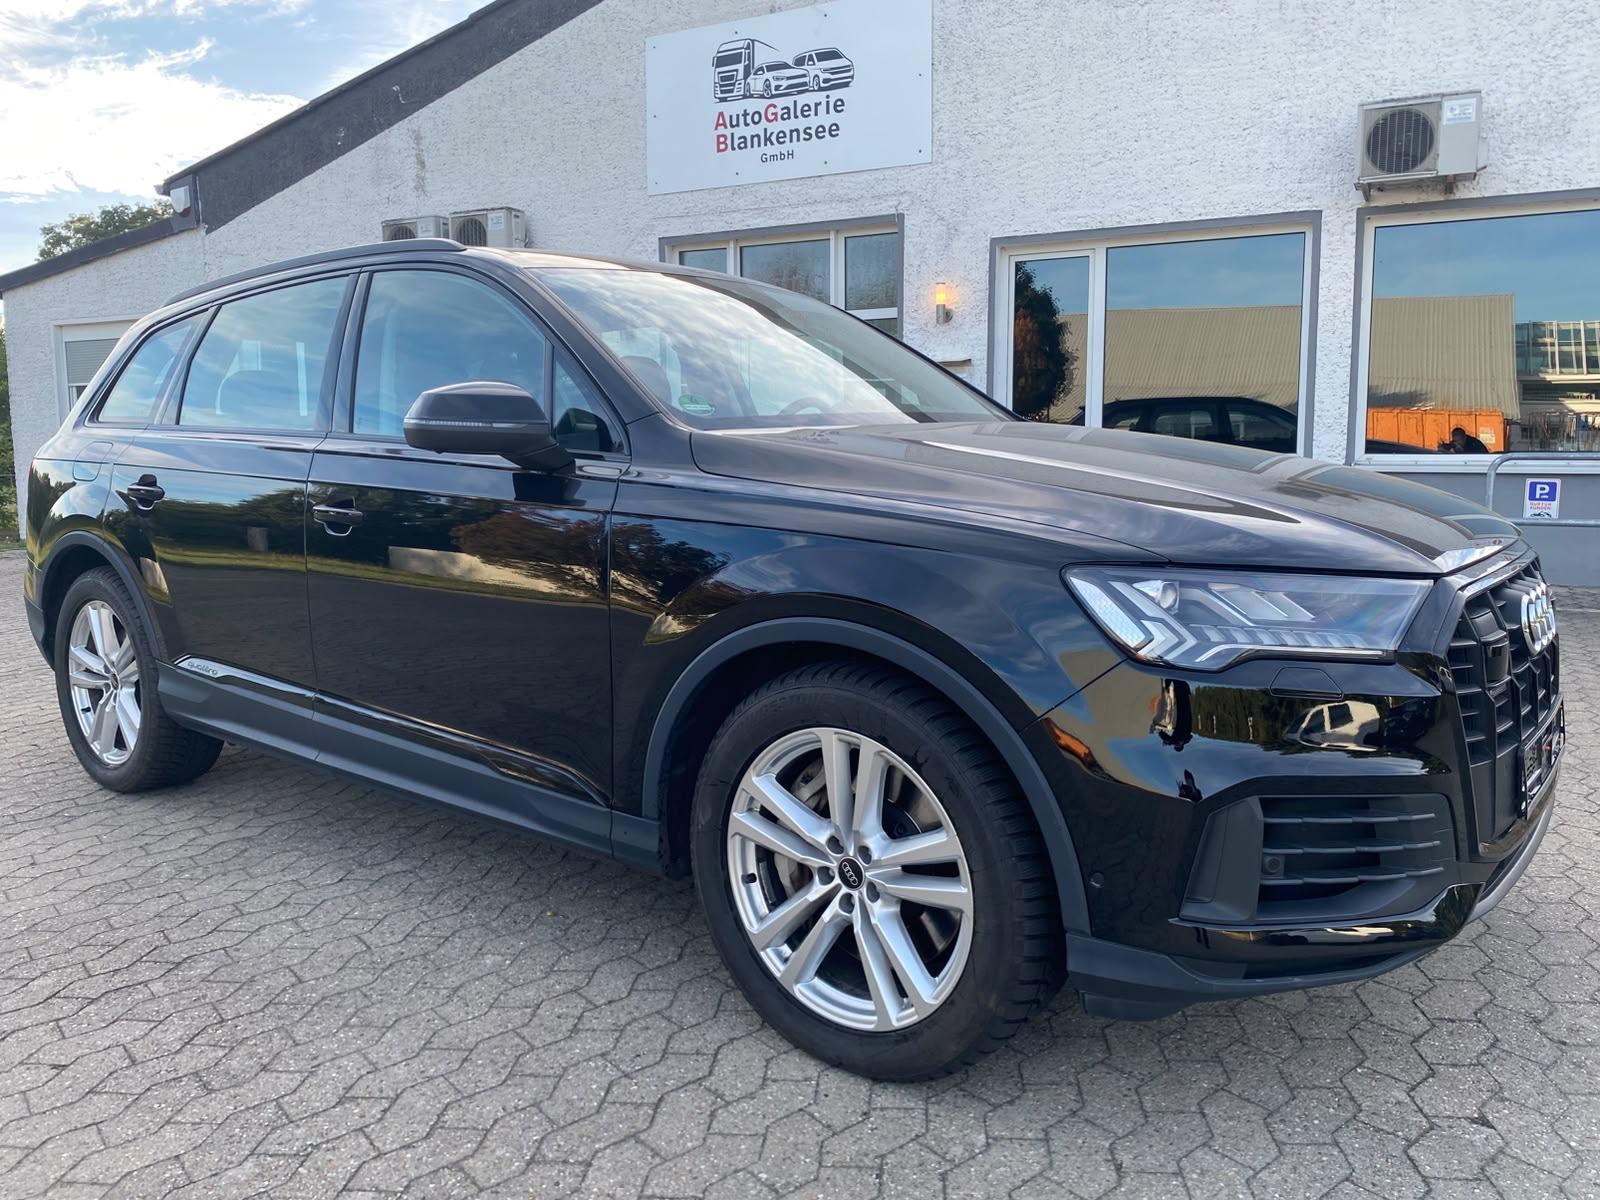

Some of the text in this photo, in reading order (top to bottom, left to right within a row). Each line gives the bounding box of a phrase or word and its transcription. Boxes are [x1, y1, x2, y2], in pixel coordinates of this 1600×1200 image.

[714, 94, 845, 130] AutoGalerie
[716, 122, 840, 153] Blankensee
[760, 149, 794, 163] GmbH
[1535, 483, 1550, 499] P
[187, 661, 218, 676] quattro
